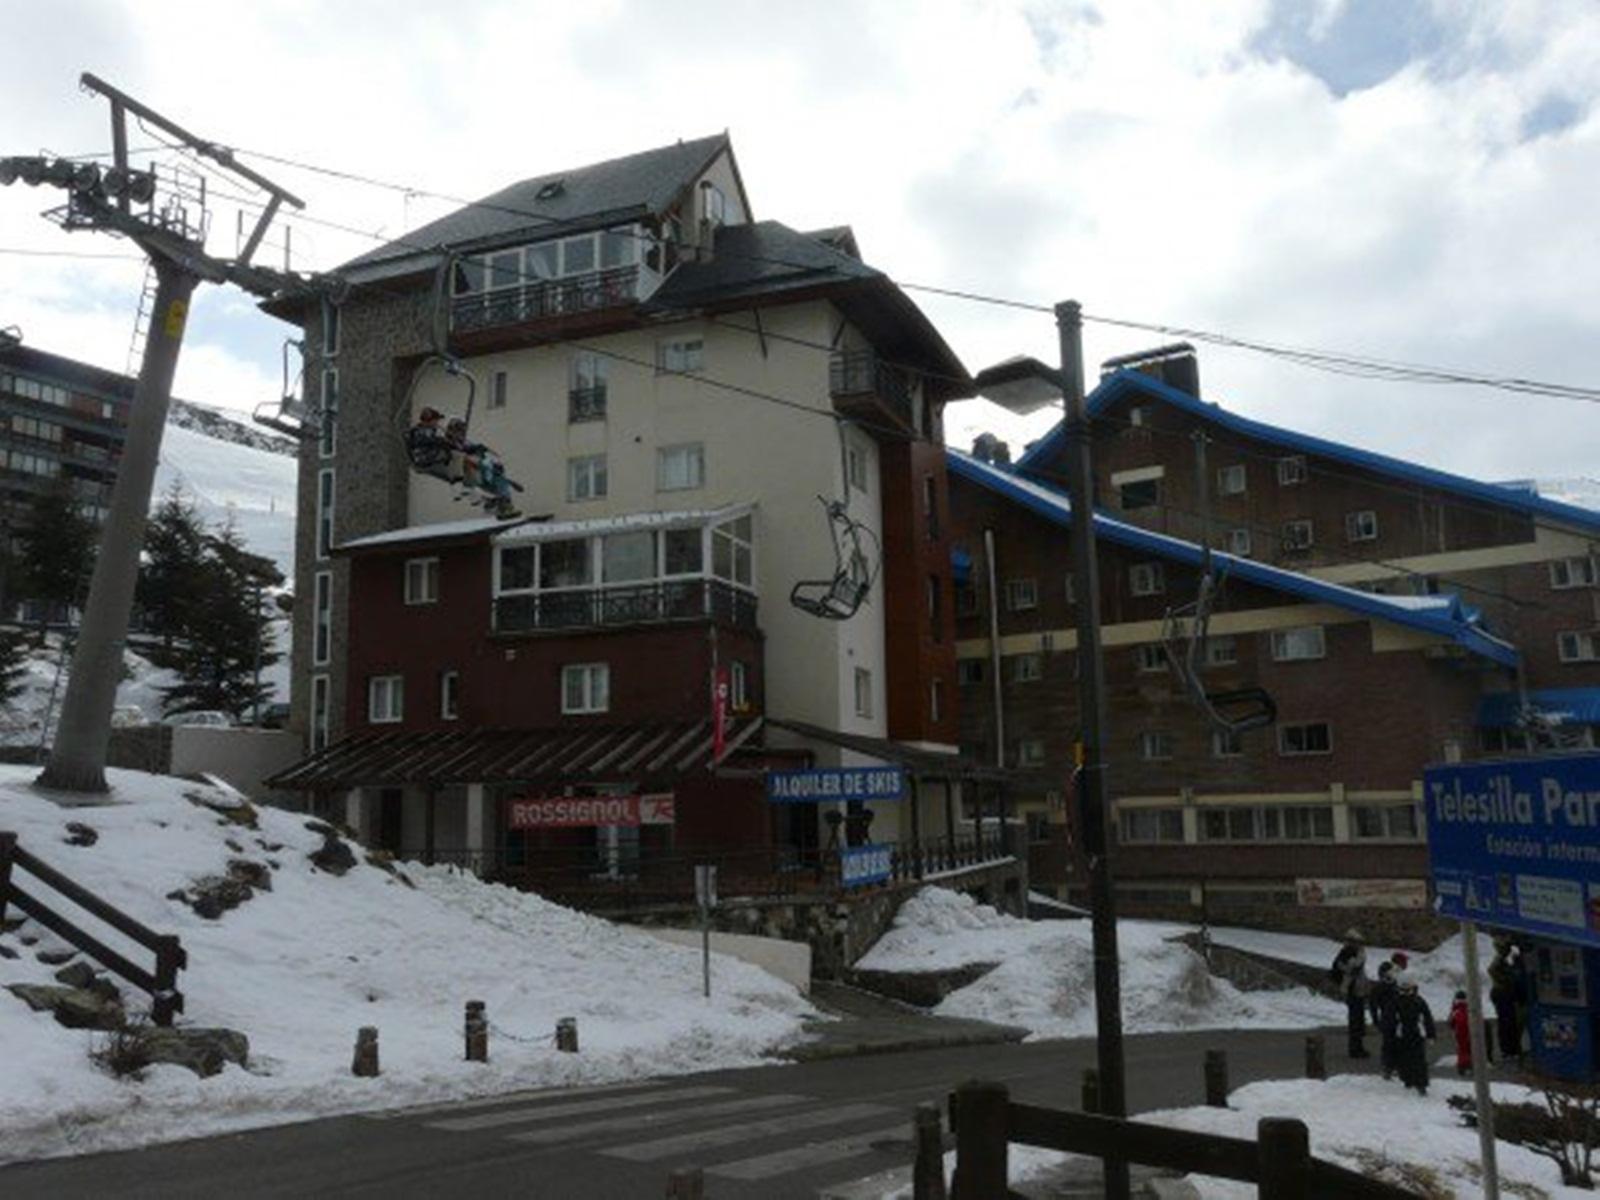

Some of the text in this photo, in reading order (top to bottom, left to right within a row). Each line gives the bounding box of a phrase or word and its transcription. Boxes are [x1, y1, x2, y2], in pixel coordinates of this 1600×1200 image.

[773, 771, 900, 797] ALQUILER DE SKIS
[512, 800, 636, 825] ROSSIGNOL
[1431, 774, 1534, 825] Telesilla
[1486, 833, 1542, 859] Estación
